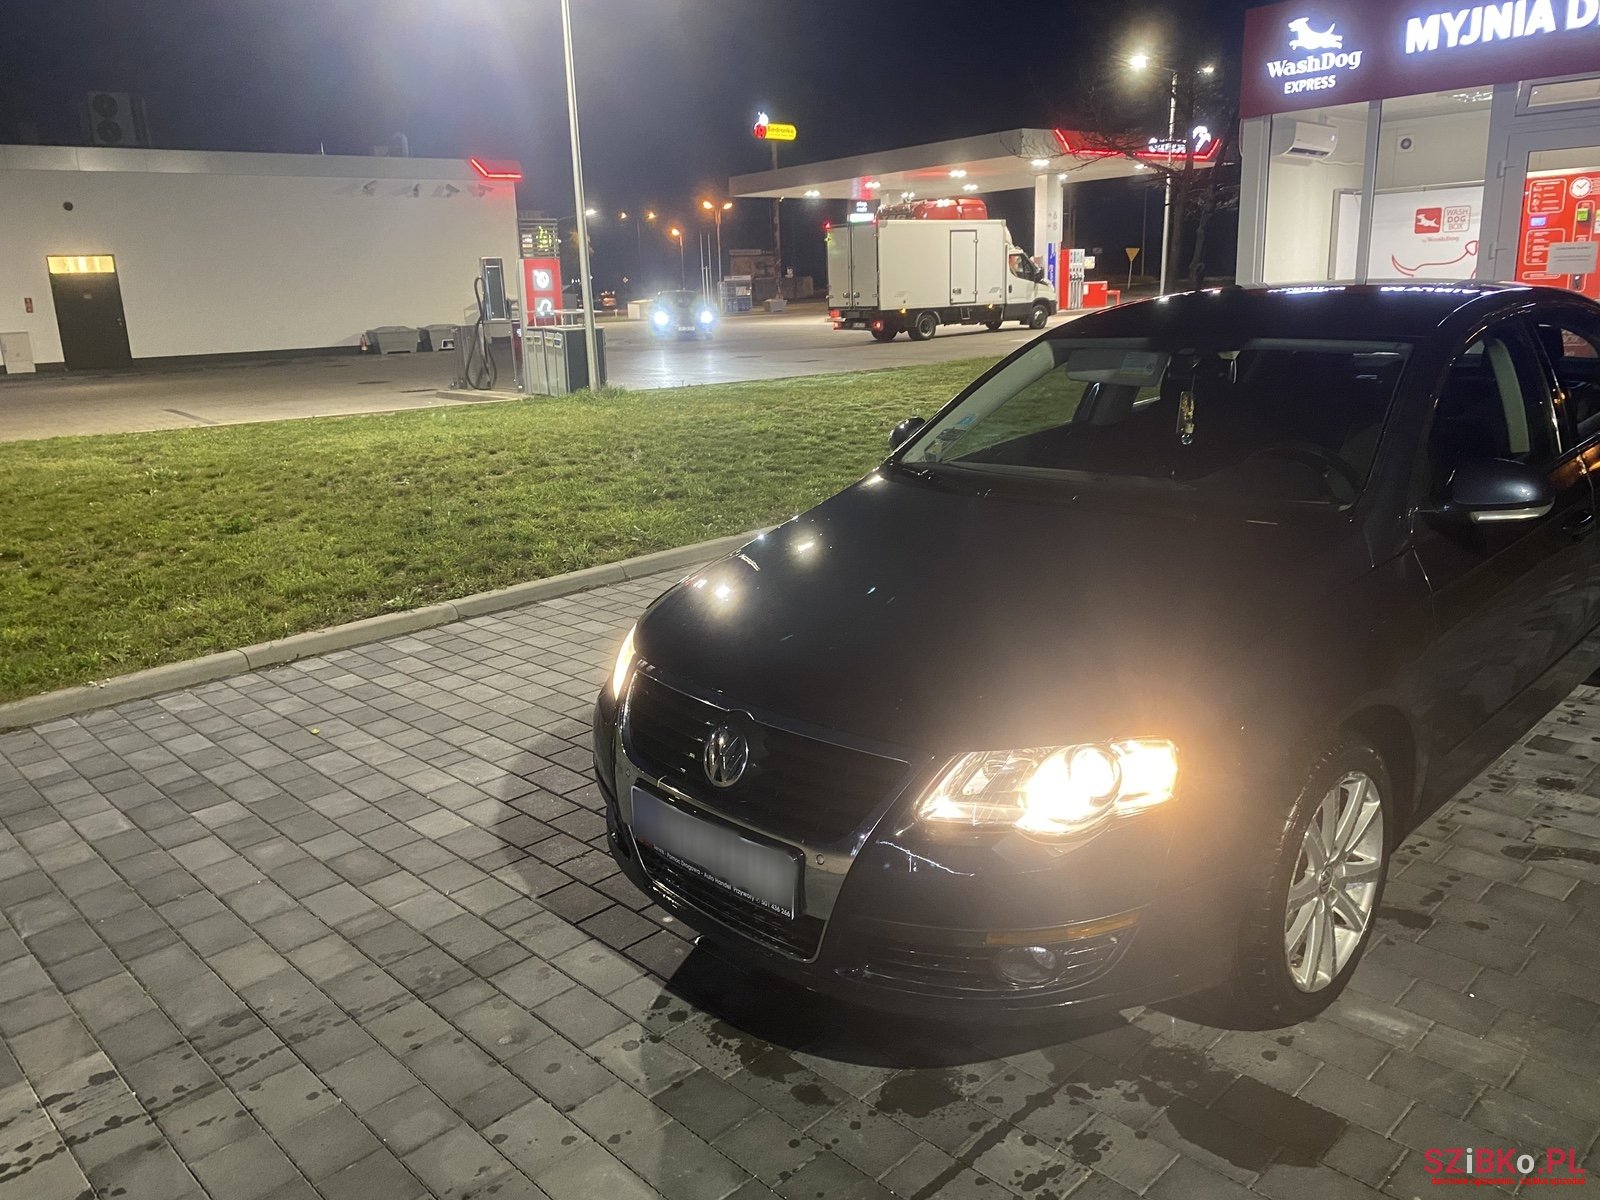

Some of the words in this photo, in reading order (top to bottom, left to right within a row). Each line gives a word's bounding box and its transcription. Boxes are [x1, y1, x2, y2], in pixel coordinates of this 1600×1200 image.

[1405, 0, 1557, 54] MYJNIA
[1565, 0, 1600, 31] D
[1267, 50, 1363, 79] WashDog
[1284, 75, 1337, 95] EXPRESS
[1446, 208, 1469, 216] WASH
[1447, 215, 1466, 223] DOG
[1447, 222, 1464, 230] BOX
